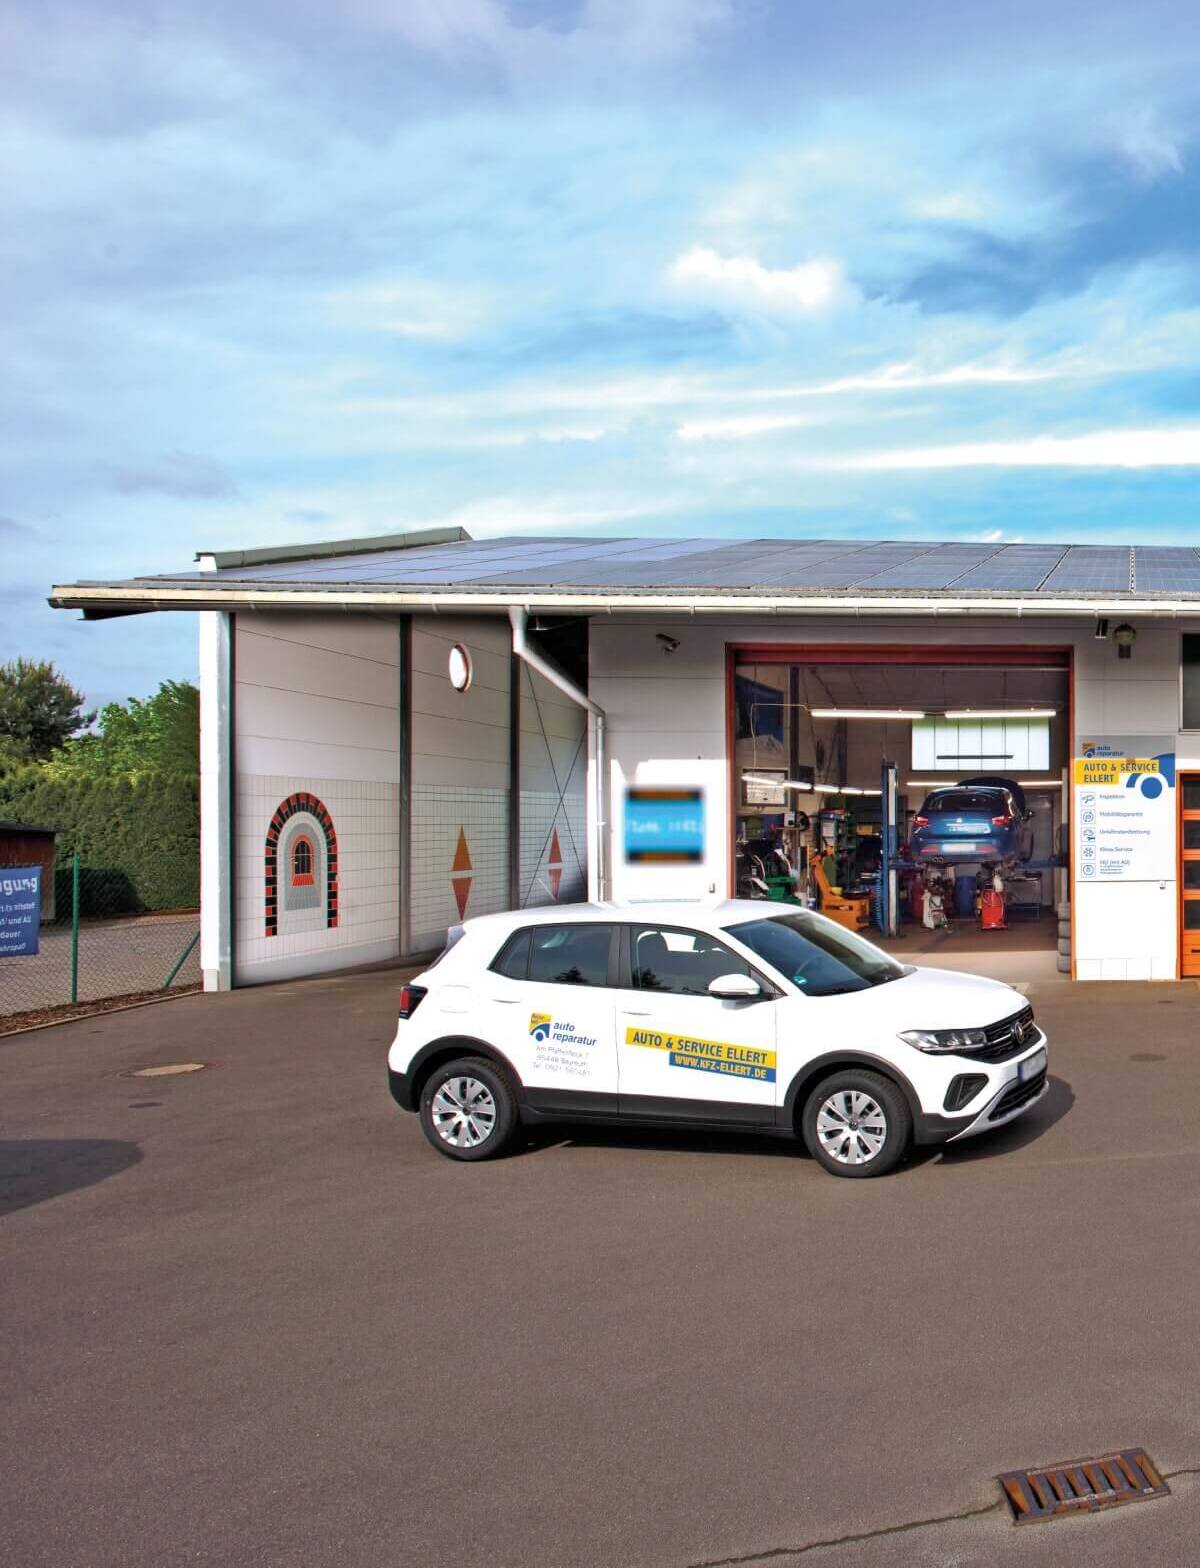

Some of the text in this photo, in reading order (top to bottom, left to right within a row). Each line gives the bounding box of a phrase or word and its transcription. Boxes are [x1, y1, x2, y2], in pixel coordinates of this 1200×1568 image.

[1083, 763, 1157, 772] AUTO & SERVICE
[1083, 774, 1114, 783] ELLERT
[553, 1022, 575, 1032] auto
[553, 1032, 597, 1046] reparatur
[632, 1031, 768, 1065] AUTO & SERVICE ELLERT
[674, 1054, 767, 1079] WWW.KFZ-ELLERT.DE
